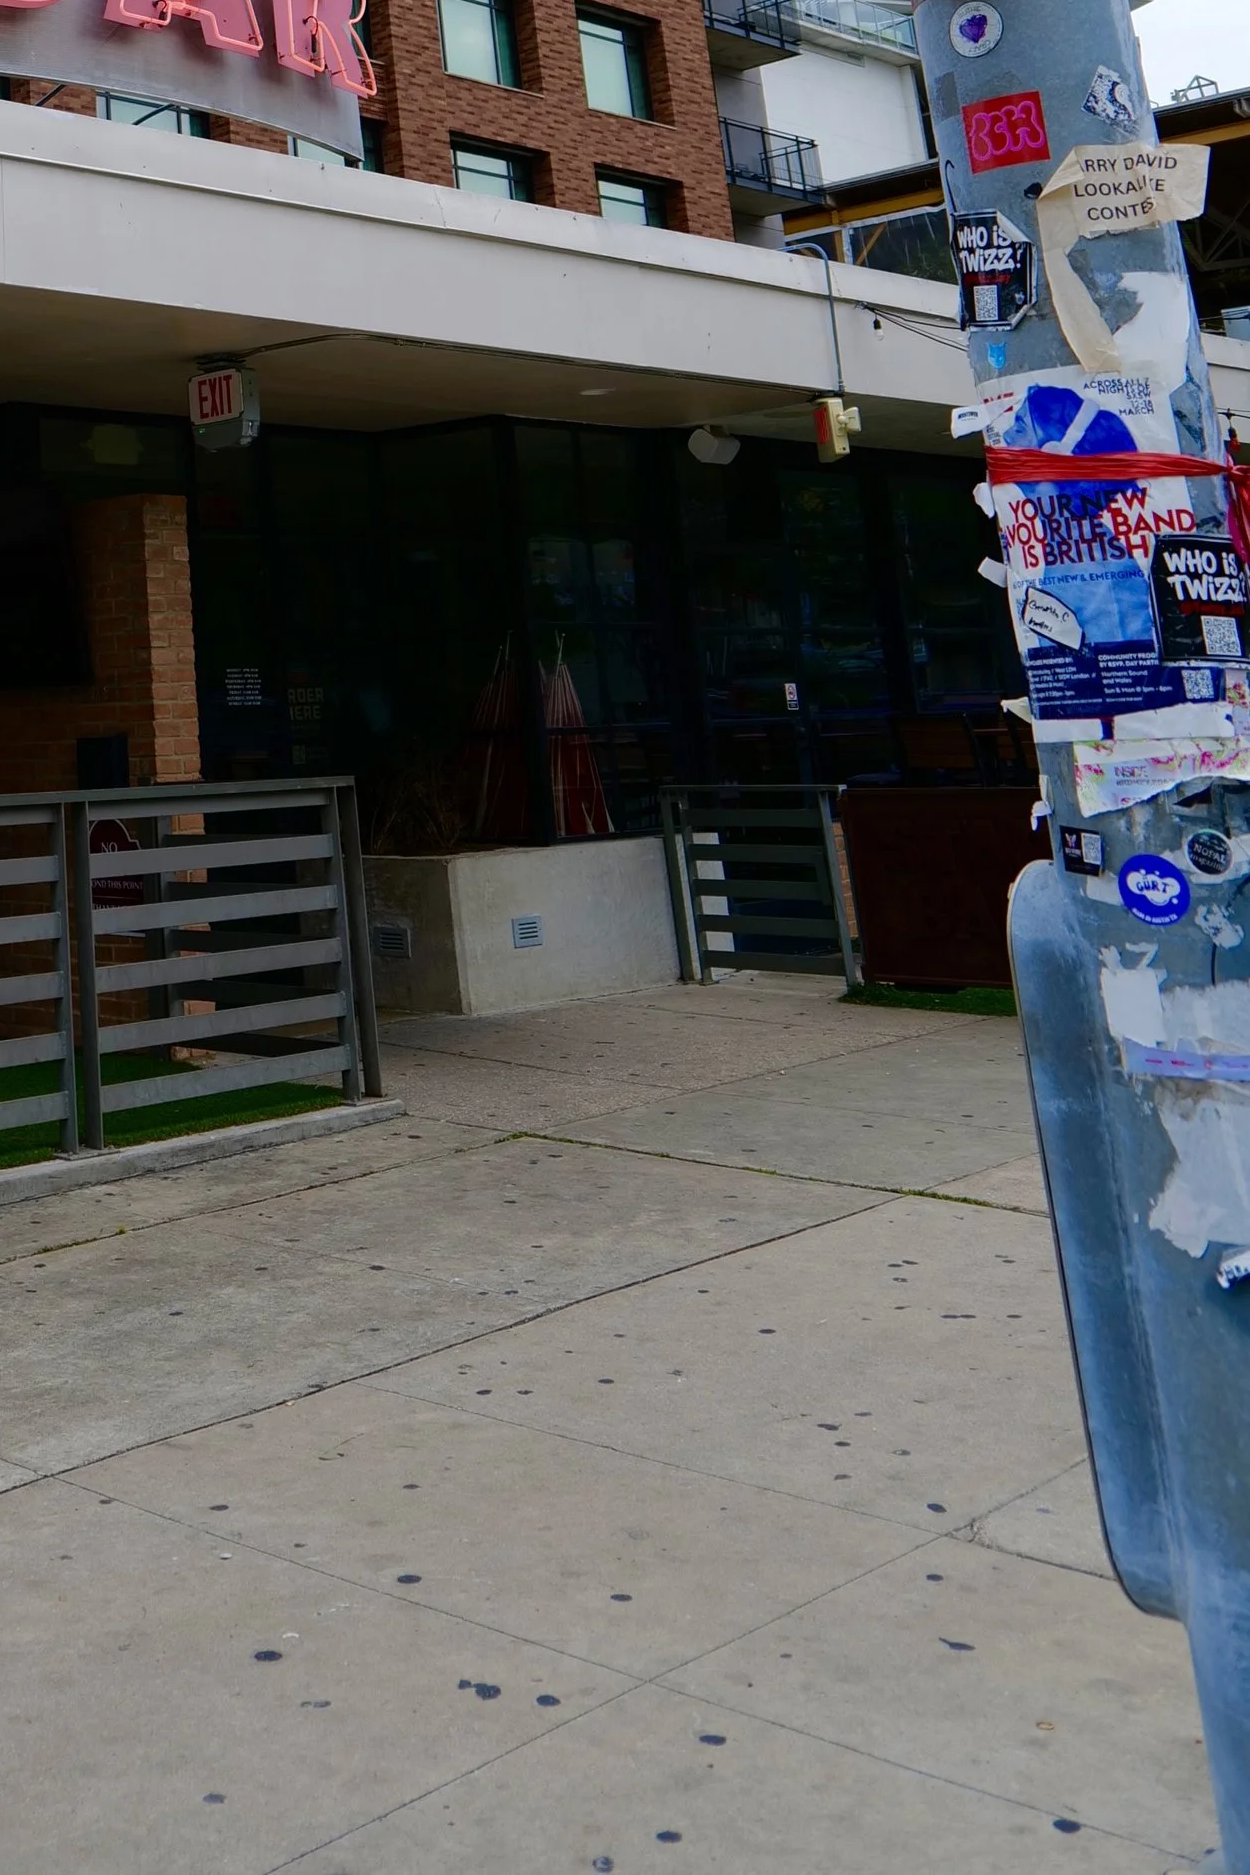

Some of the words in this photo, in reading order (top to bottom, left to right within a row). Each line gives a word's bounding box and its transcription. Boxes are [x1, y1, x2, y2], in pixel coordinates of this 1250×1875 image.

[1123, 153, 1178, 171] DAVID
[957, 225, 988, 248] WHO
[197, 374, 232, 419] EXIT
[1118, 406, 1155, 416] MARCH
[1008, 493, 1074, 523] YOUR
[1081, 487, 1148, 519] NEW
[1111, 509, 1197, 537] BAND
[1021, 544, 1040, 569] IS
[1041, 535, 1149, 566] BRITISH
[1163, 548, 1217, 573] WHO
[1039, 576, 1056, 586] BEST
[1057, 574, 1079, 584] NEW
[1090, 570, 1145, 581] EMERGING
[1098, 653, 1137, 661] COMMUNITY
[100, 842, 117, 853] NO
[1194, 843, 1225, 863] NOPAL
[107, 880, 121, 889] THIS
[122, 881, 143, 890] POINT
